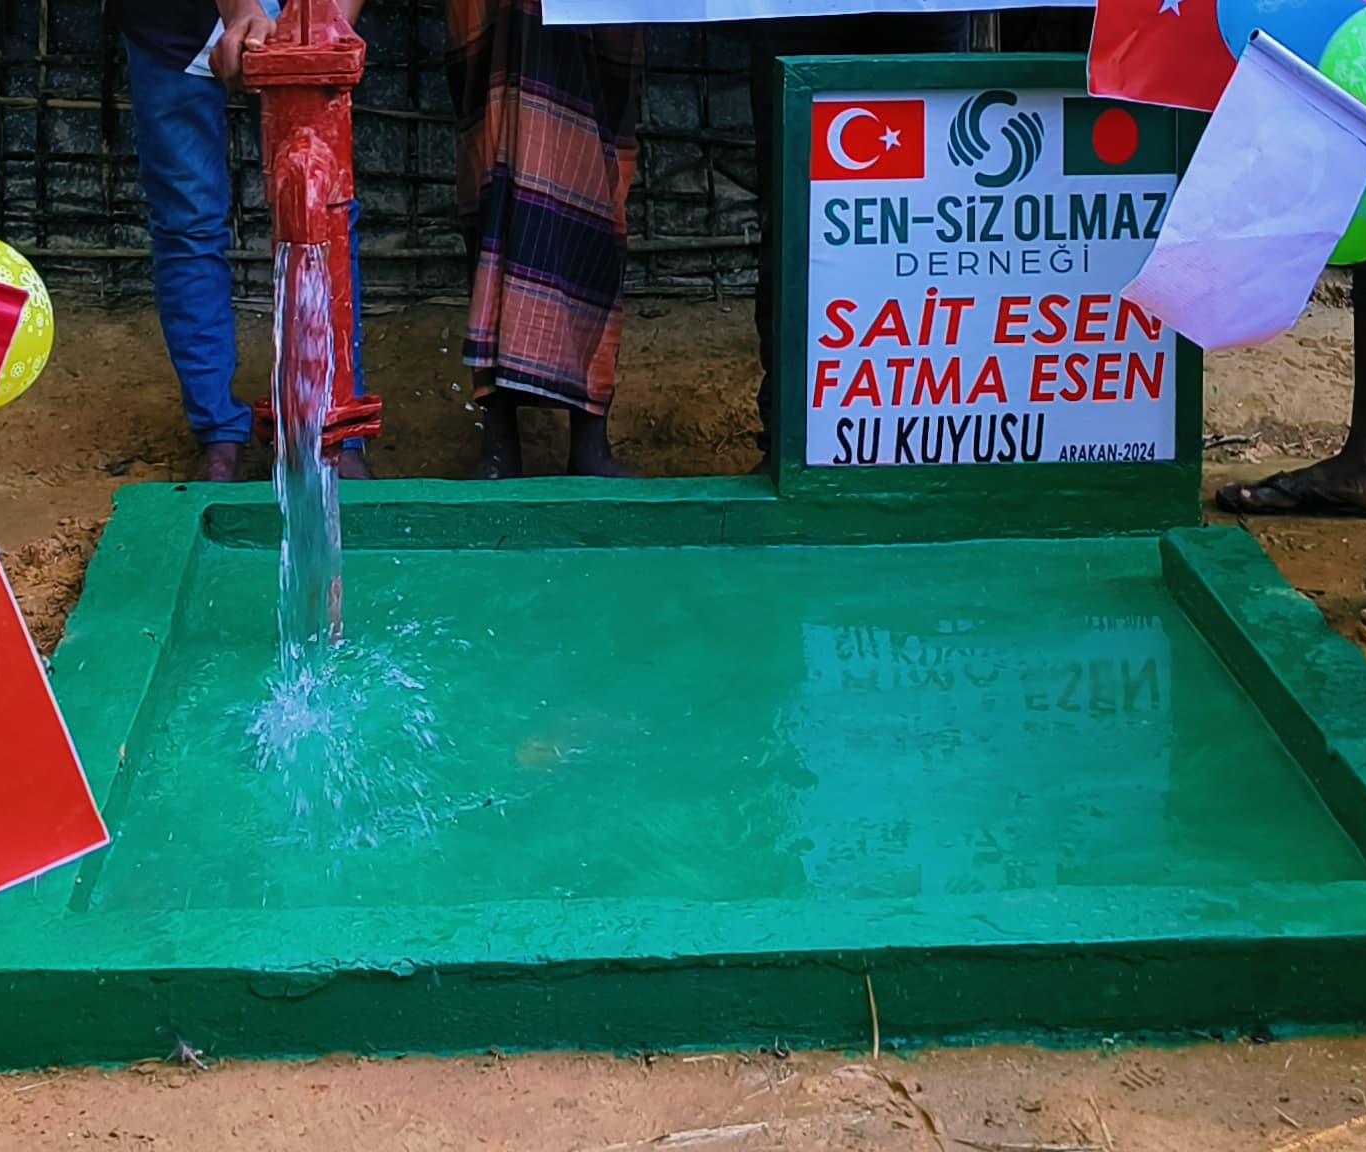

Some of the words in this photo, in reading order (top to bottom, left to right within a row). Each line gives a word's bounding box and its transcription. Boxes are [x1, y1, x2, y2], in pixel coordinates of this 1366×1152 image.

[1015, 192, 1167, 242] OLMAZ
[896, 244, 1090, 277] DERNEĞİ
[818, 287, 975, 348] SAİT
[994, 294, 1162, 345] ESEN
[812, 356, 1008, 408] FATMA
[1030, 352, 1165, 403] ESEN
[833, 417, 881, 463] SU
[895, 413, 1045, 464] KUYUSU
[1059, 442, 1156, 462] ARAKAN-2024
